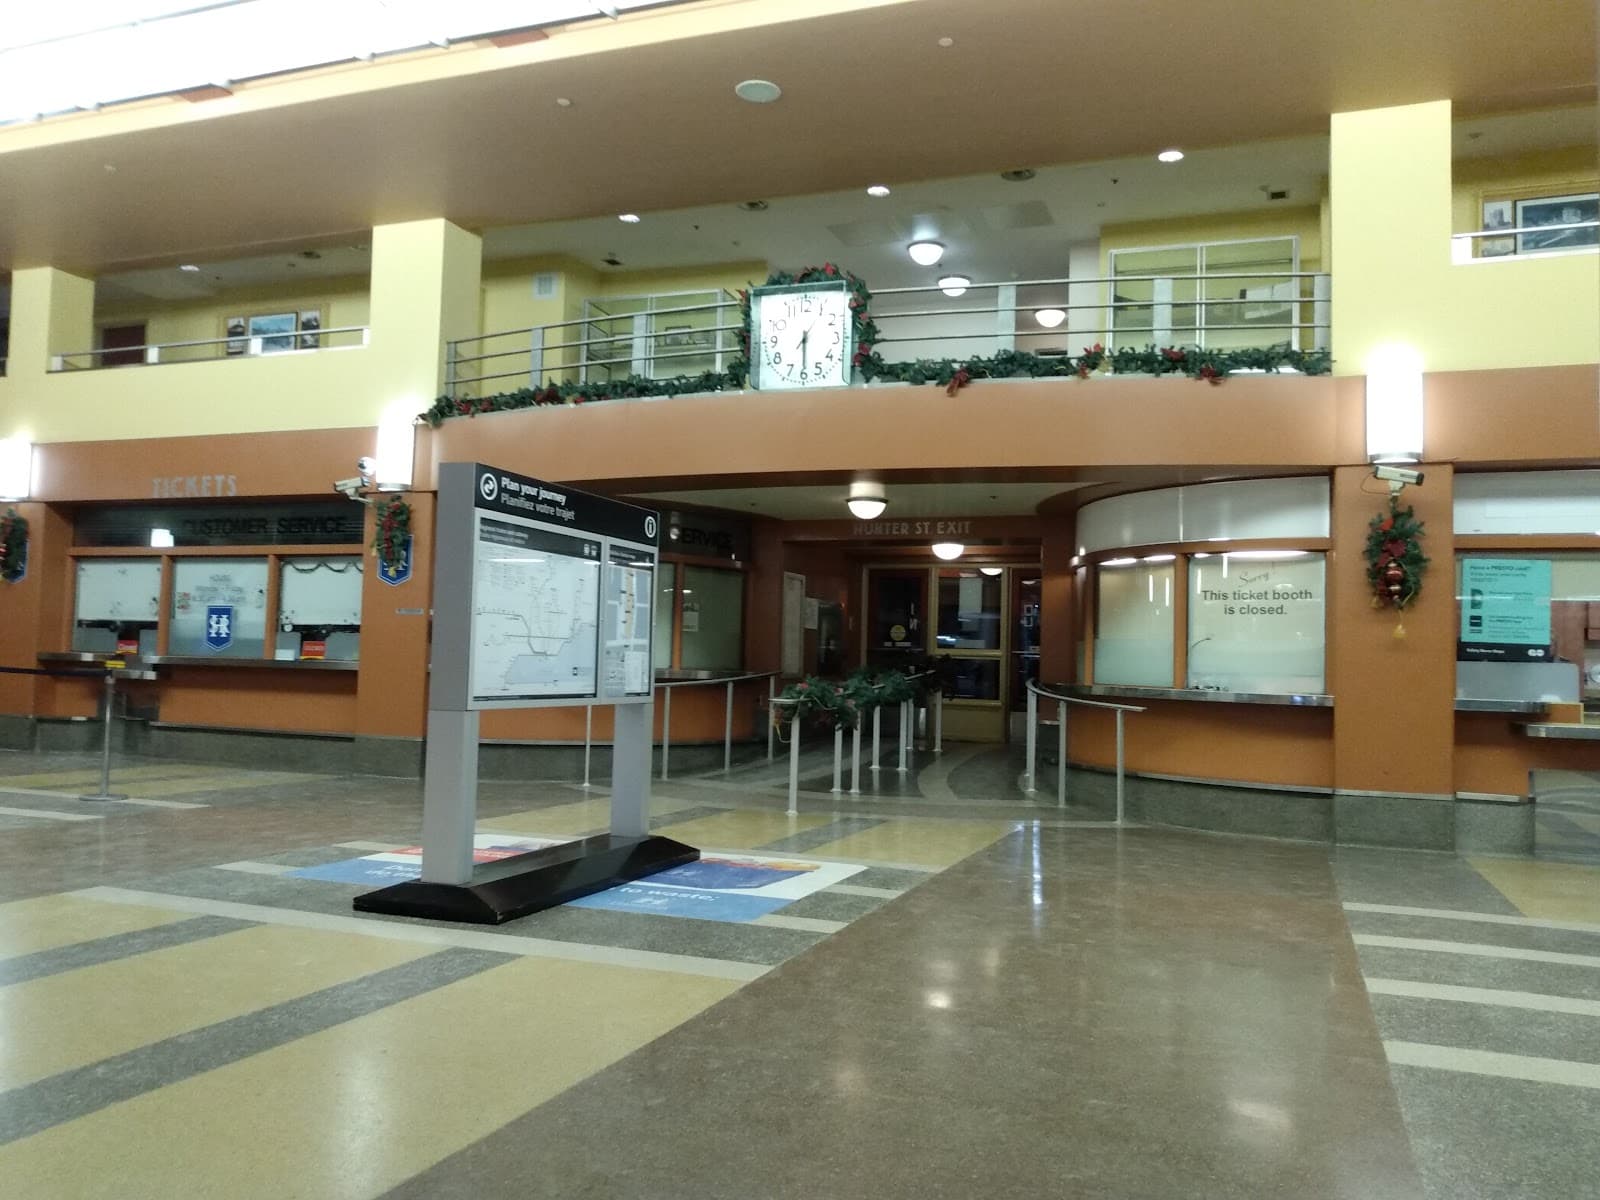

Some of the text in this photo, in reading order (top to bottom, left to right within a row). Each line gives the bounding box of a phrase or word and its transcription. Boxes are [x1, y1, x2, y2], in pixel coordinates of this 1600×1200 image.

[787, 305, 796, 318] 11
[800, 299, 812, 313] 12
[772, 319, 787, 332] 10
[828, 313, 836, 326] 2
[770, 335, 779, 349] 9
[832, 331, 840, 345] 3
[773, 352, 782, 365] 8
[825, 348, 834, 362] 4
[786, 364, 795, 377] 7
[800, 369, 808, 381] 6
[814, 362, 823, 376] 5
[152, 475, 237, 498] TICKETS
[501, 476, 567, 506] Plan your journey
[501, 493, 575, 522] Planifiez votre trajet
[183, 516, 348, 537] CUSTOMER SERVICE
[853, 520, 972, 536] HUNTER ST EXIT
[1201, 588, 1313, 601] This ticket booth
[1223, 603, 1287, 616] is closed.
